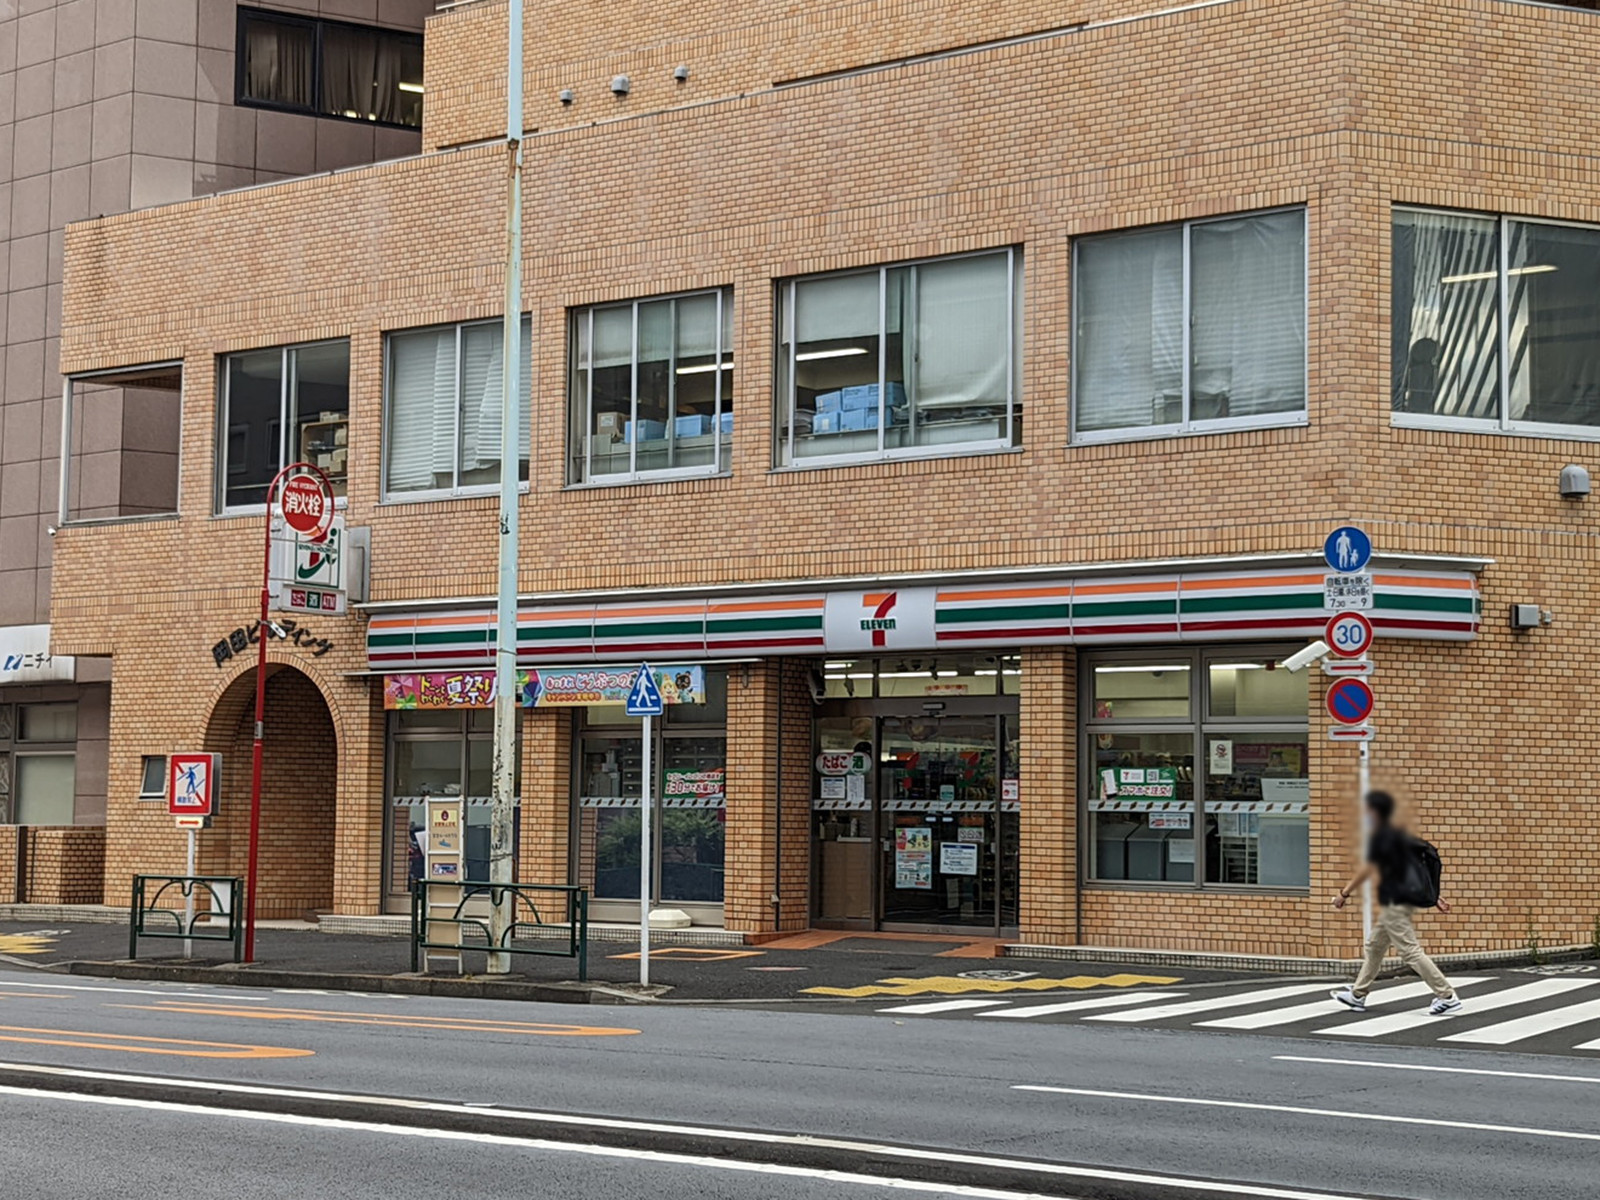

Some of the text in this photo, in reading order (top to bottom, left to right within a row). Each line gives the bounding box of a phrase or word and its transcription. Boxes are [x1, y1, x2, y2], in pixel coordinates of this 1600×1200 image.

[285, 490, 321, 517] 消火栓
[323, 595, 336, 608] ATM
[1337, 624, 1362, 645] 30
[24, 652, 52, 669] ニチイ
[446, 675, 497, 705] 夏祭り
[822, 755, 848, 769] たばこ
[852, 755, 864, 769] 酒
